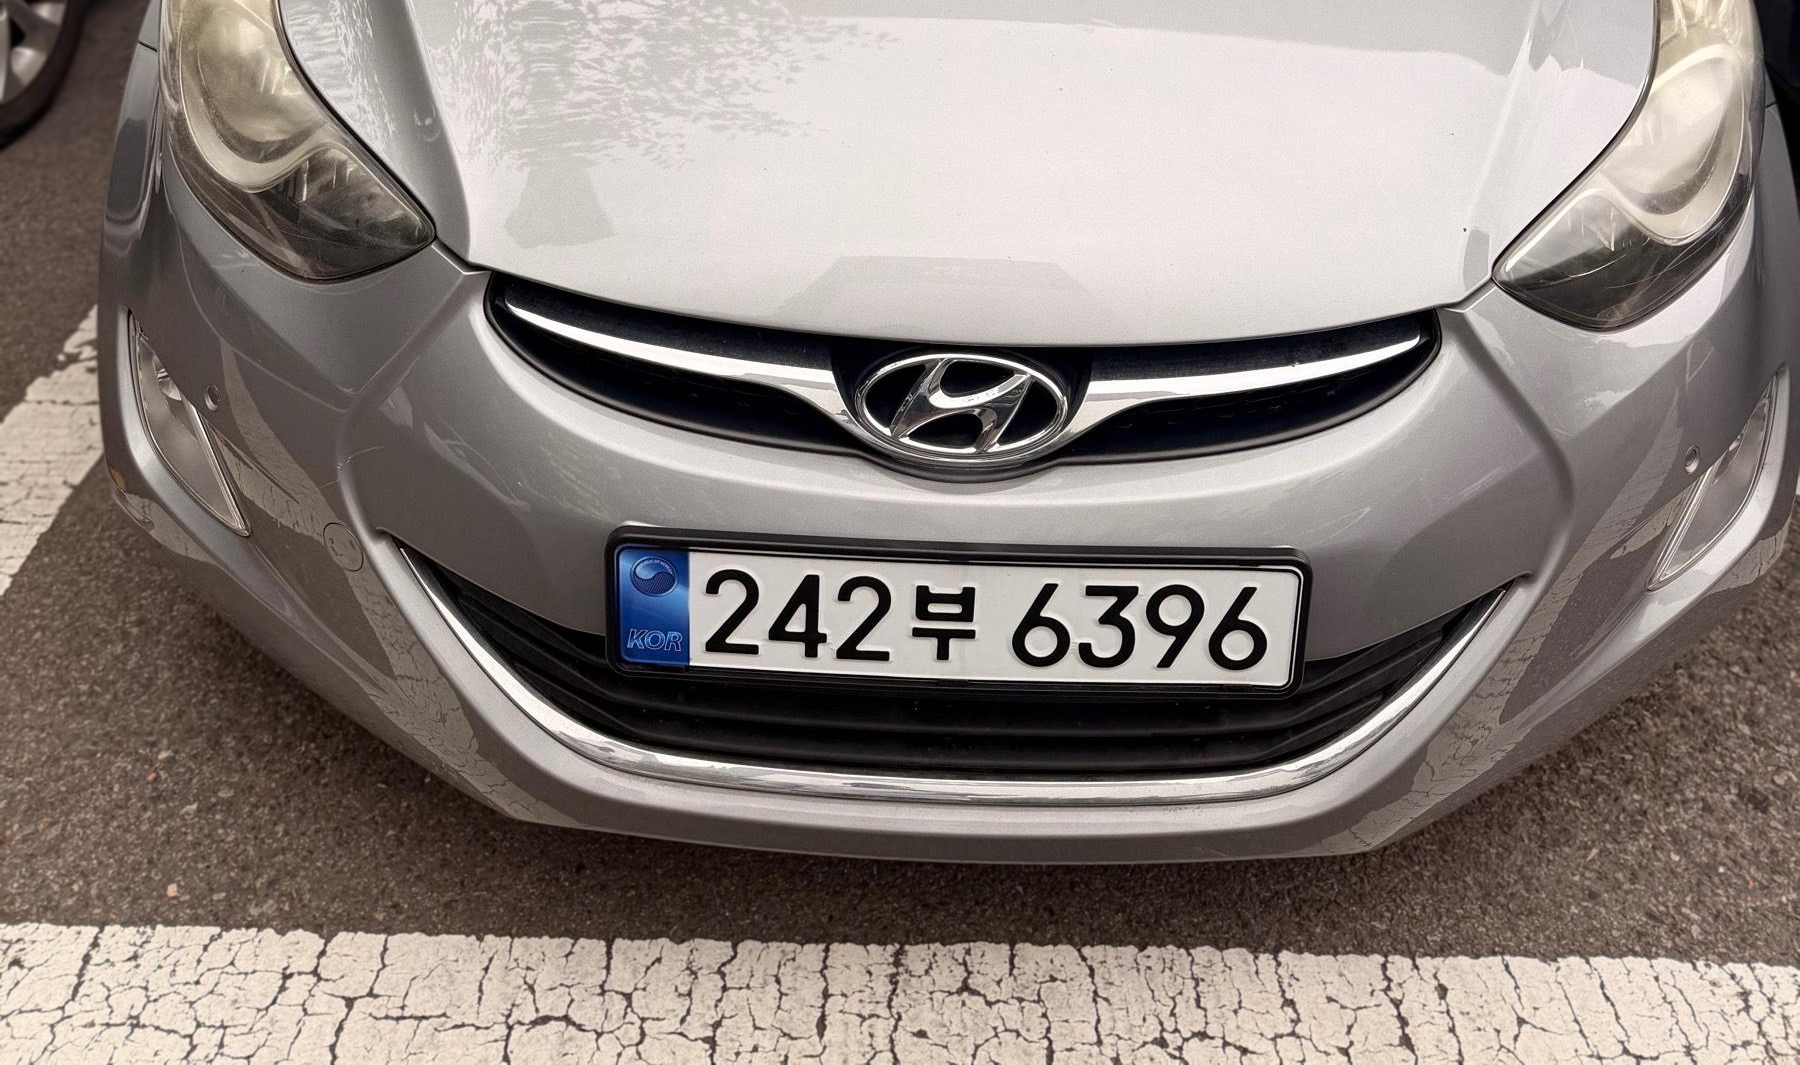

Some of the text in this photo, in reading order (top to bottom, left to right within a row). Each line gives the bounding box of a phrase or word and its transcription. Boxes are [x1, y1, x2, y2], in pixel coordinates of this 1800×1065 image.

[626, 628, 683, 652] KOR
[705, 569, 1268, 671] 242부 6396
